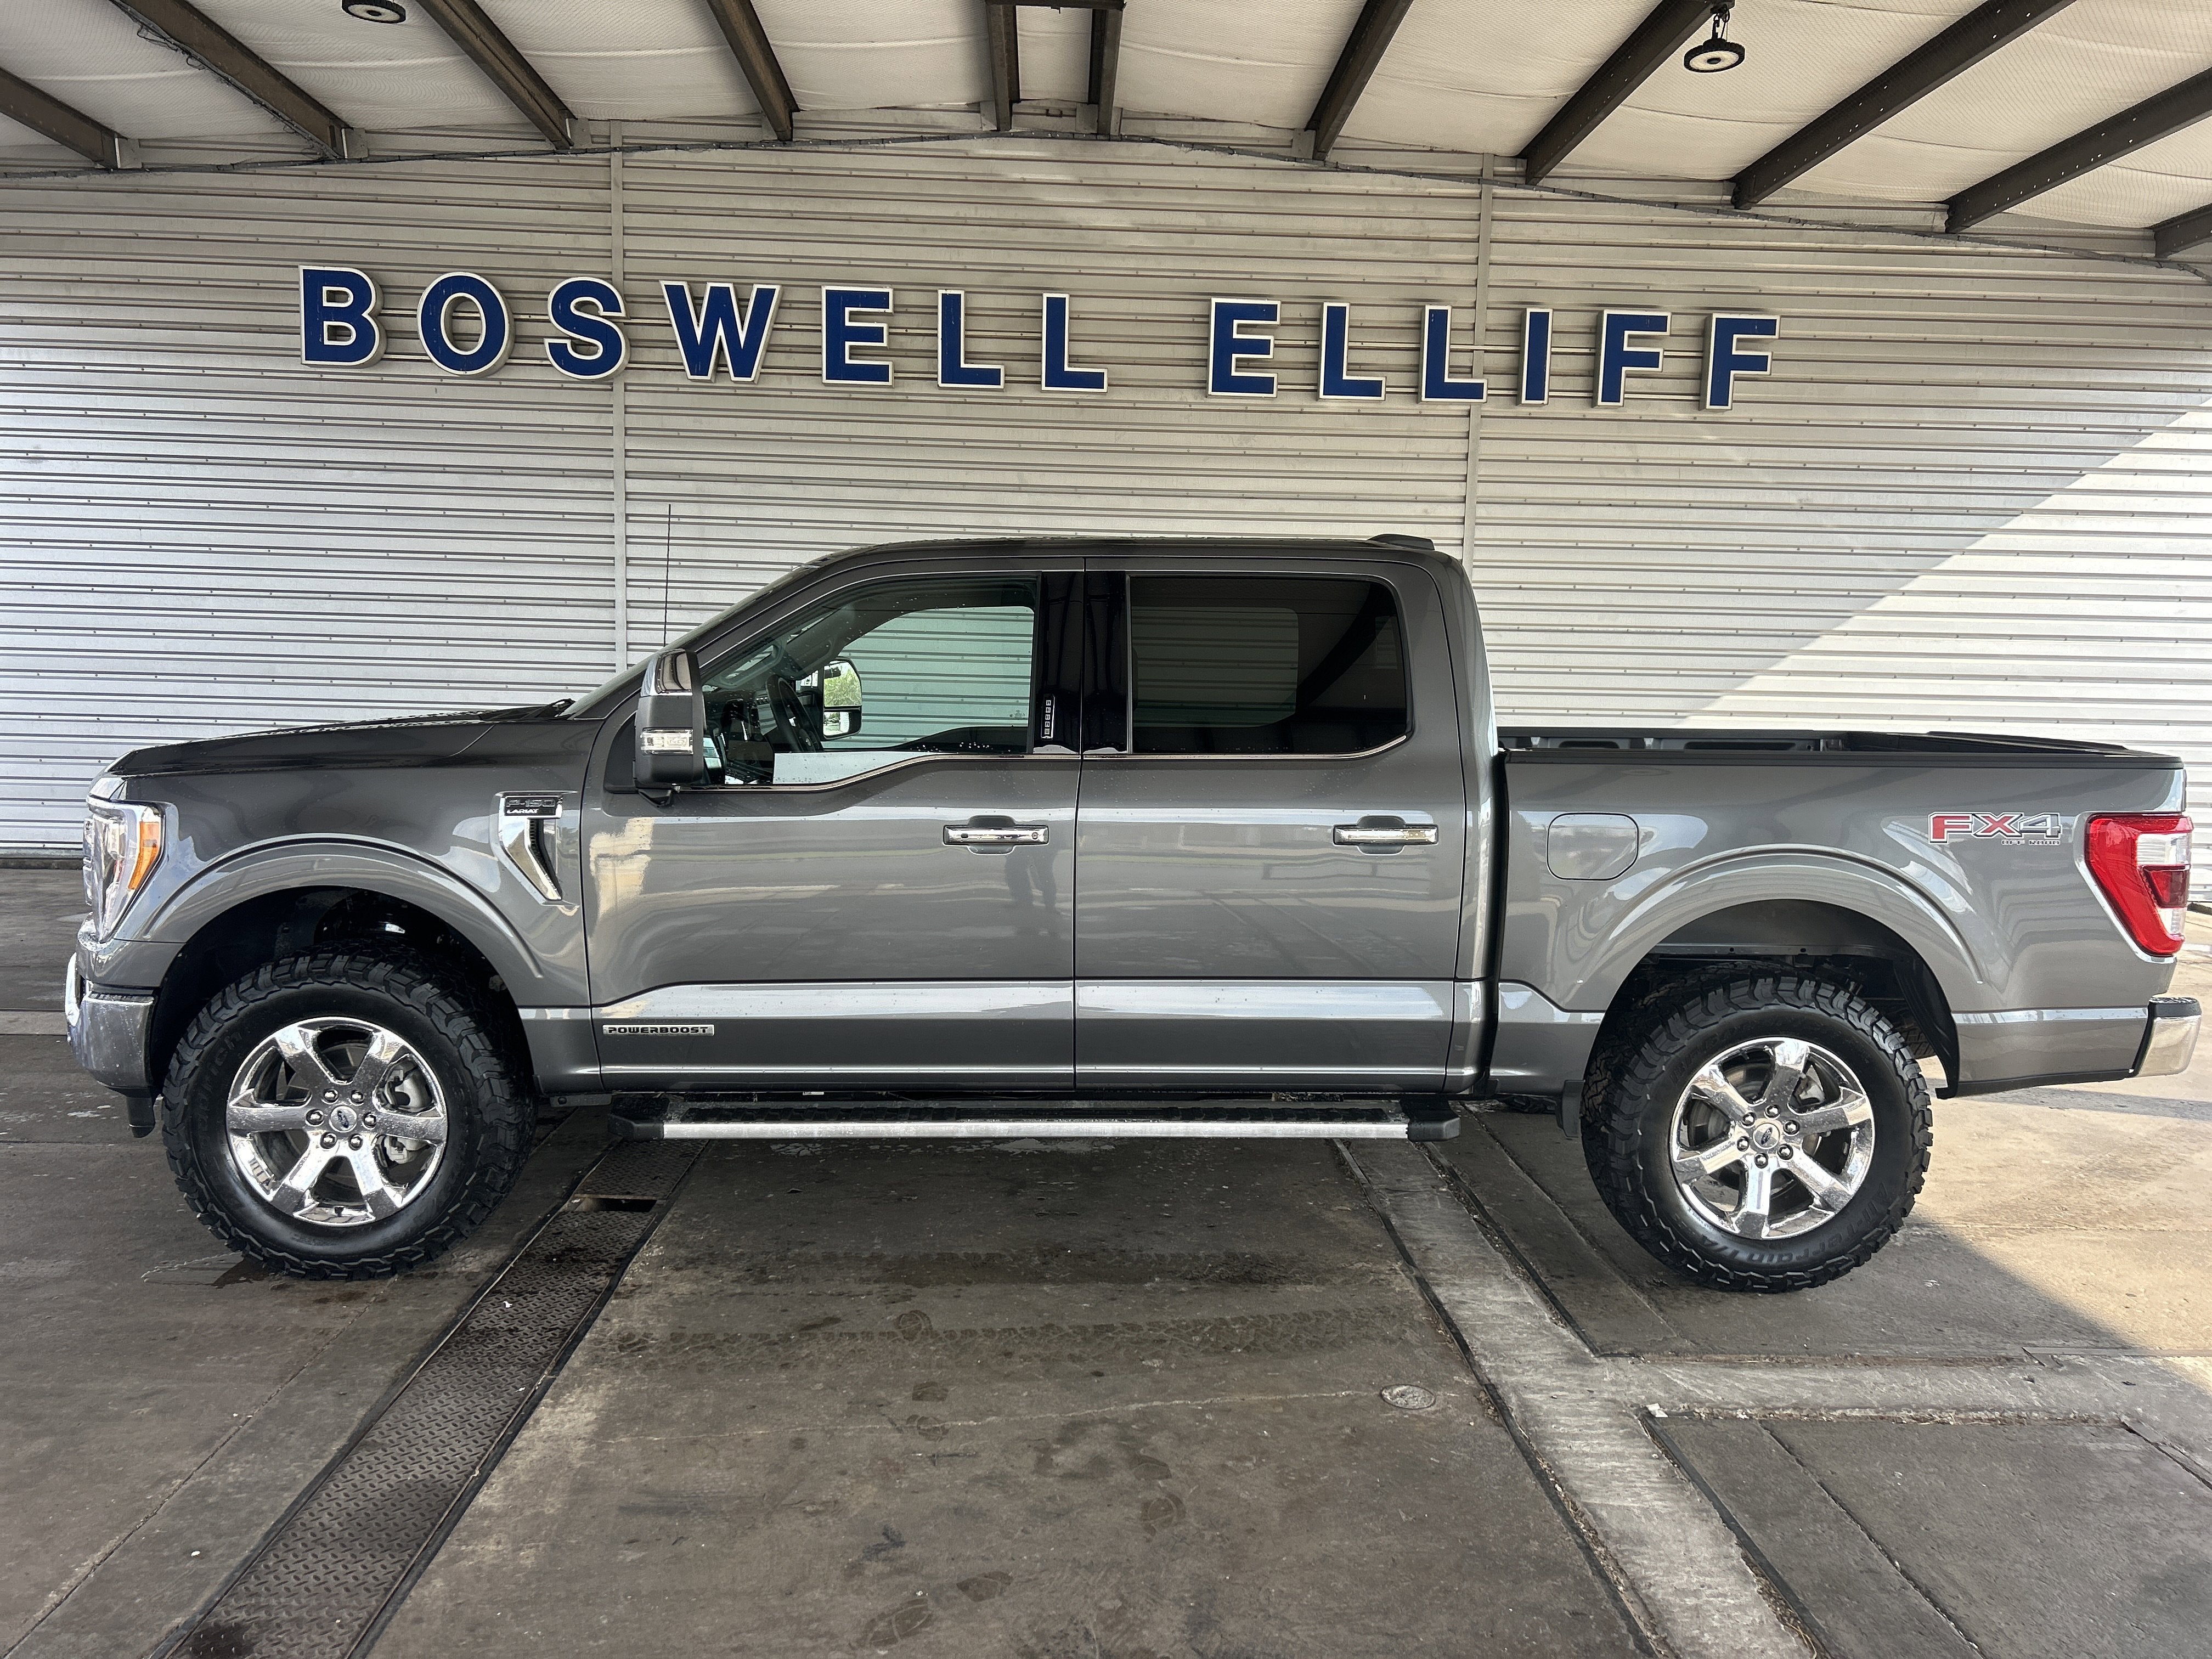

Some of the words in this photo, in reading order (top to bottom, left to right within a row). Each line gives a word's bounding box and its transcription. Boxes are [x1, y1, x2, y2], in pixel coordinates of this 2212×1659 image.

[299, 265, 1108, 393] BOSWELL
[1208, 297, 1780, 410] ELLIFF
[1928, 812, 2062, 844] FX4
